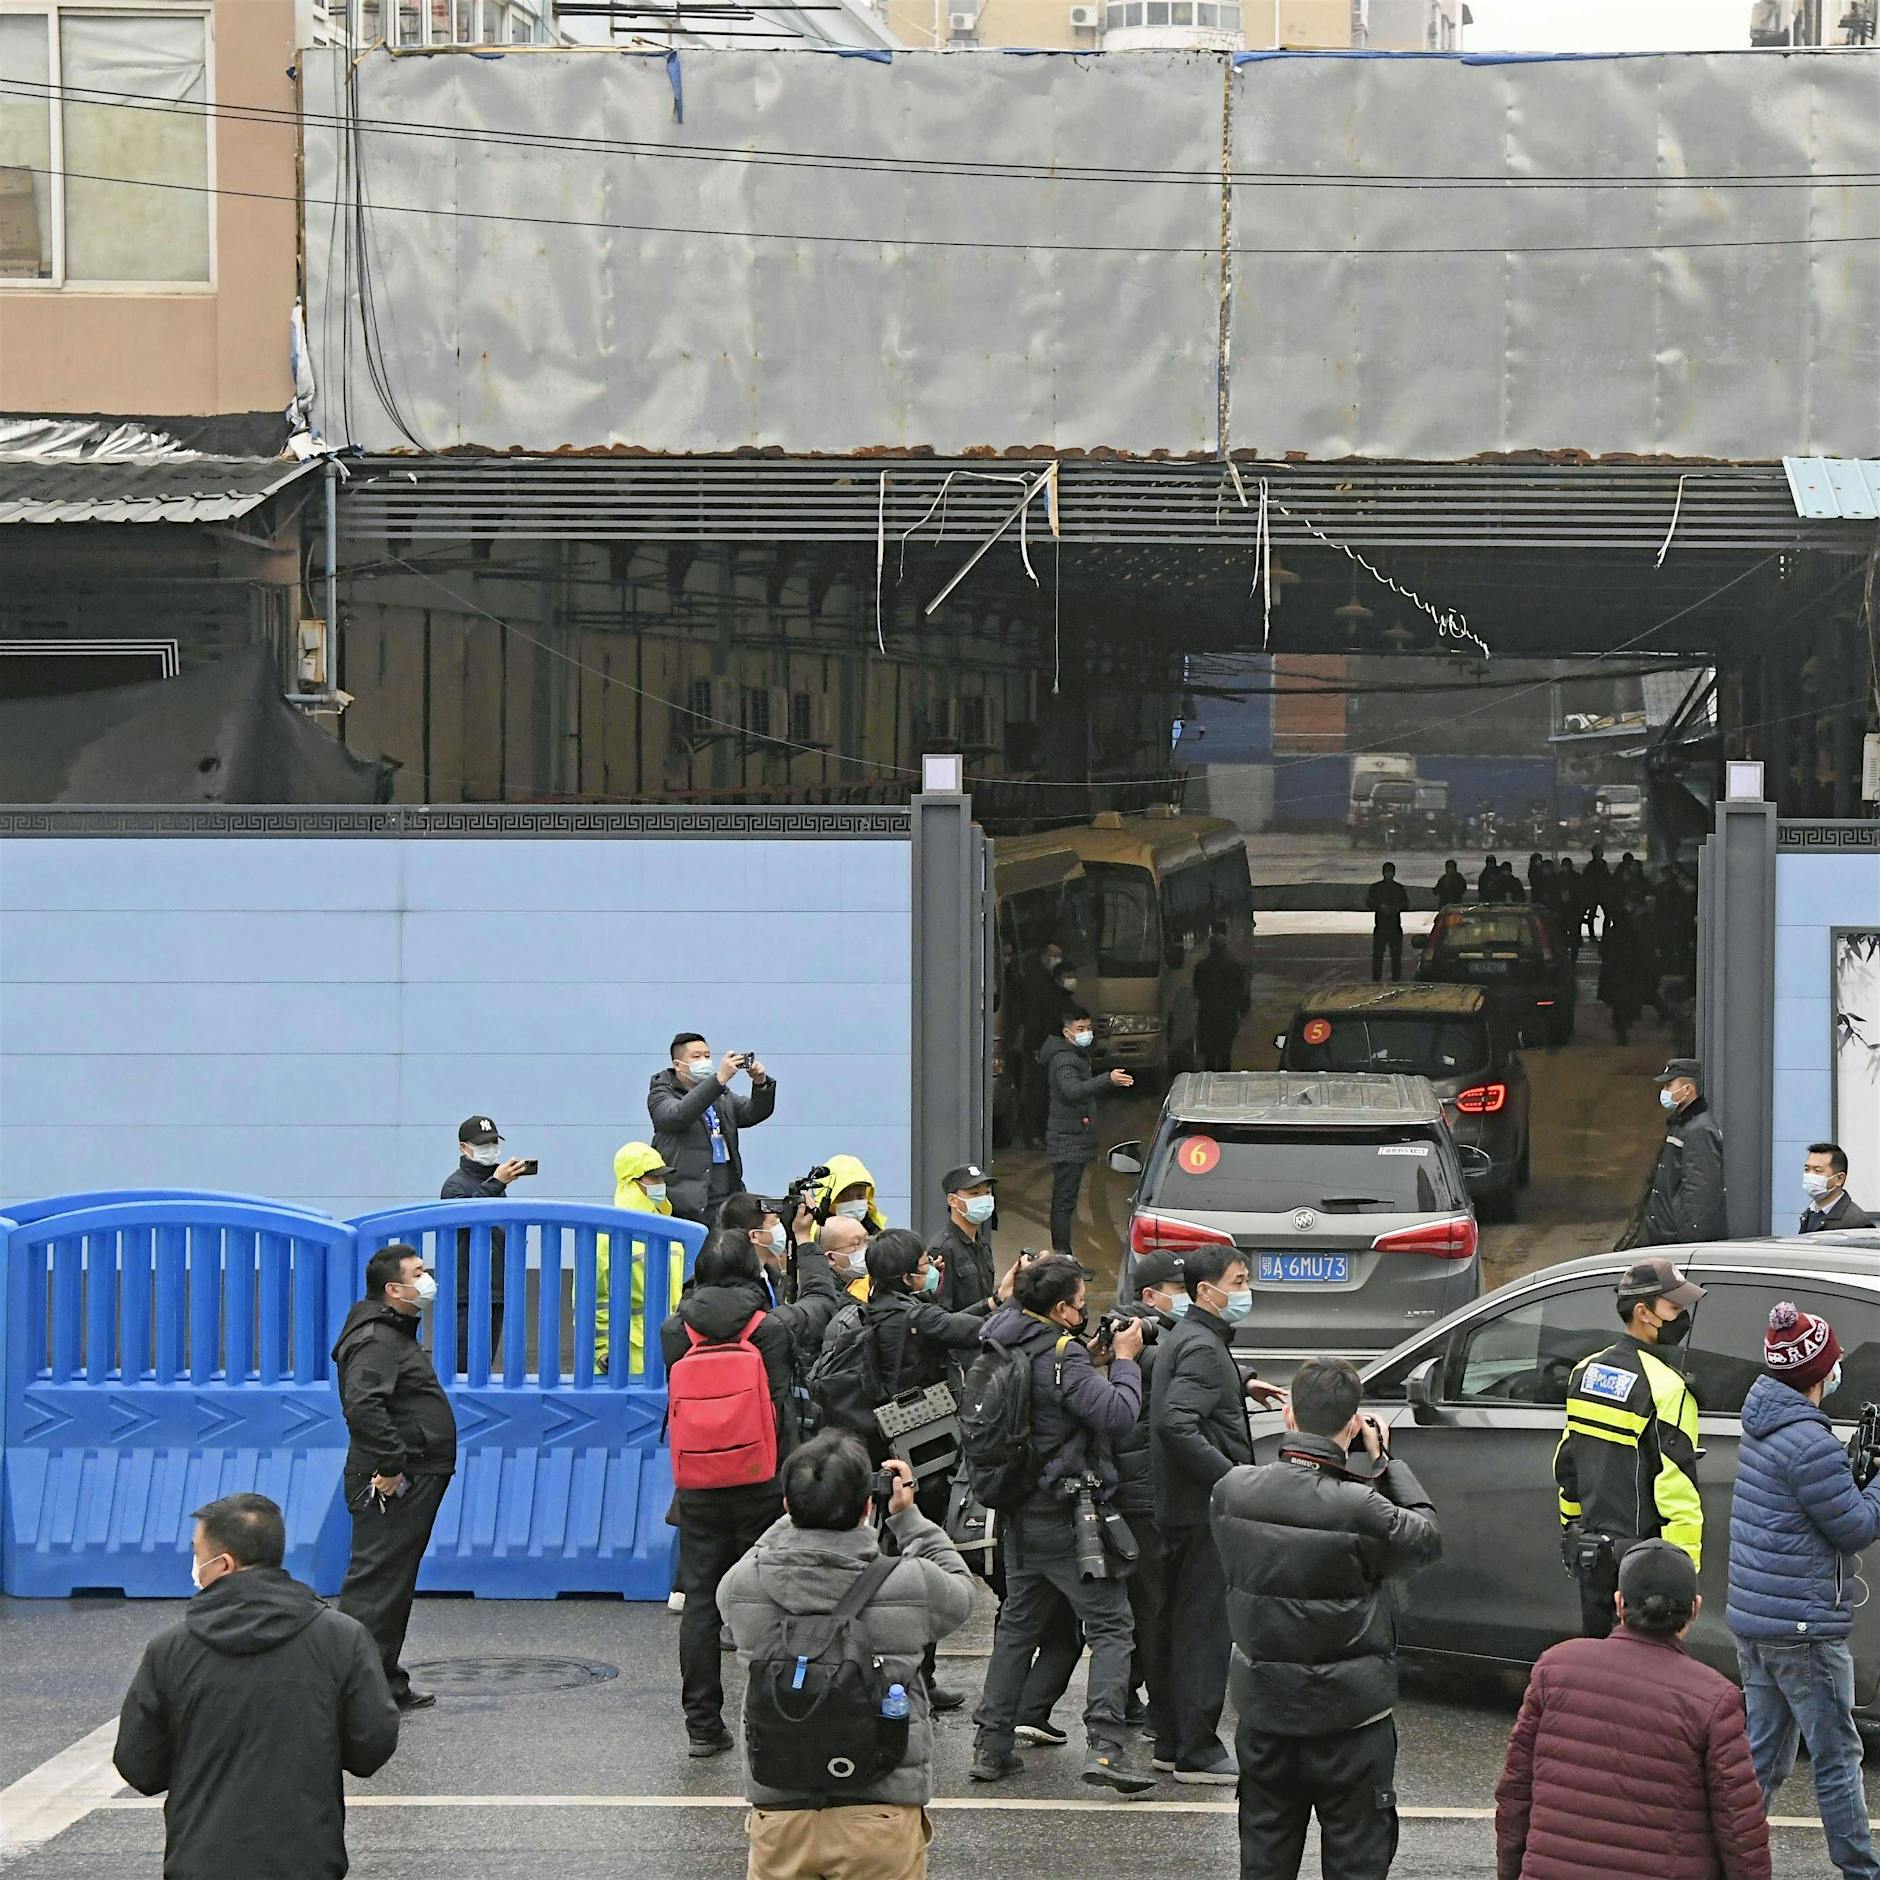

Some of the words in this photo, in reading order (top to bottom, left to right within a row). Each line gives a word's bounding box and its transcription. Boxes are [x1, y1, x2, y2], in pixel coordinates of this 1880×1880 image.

[1311, 1023, 1323, 1039] 5
[1190, 1142, 1206, 1166] 6
[1290, 1457, 1320, 1470] Canon
